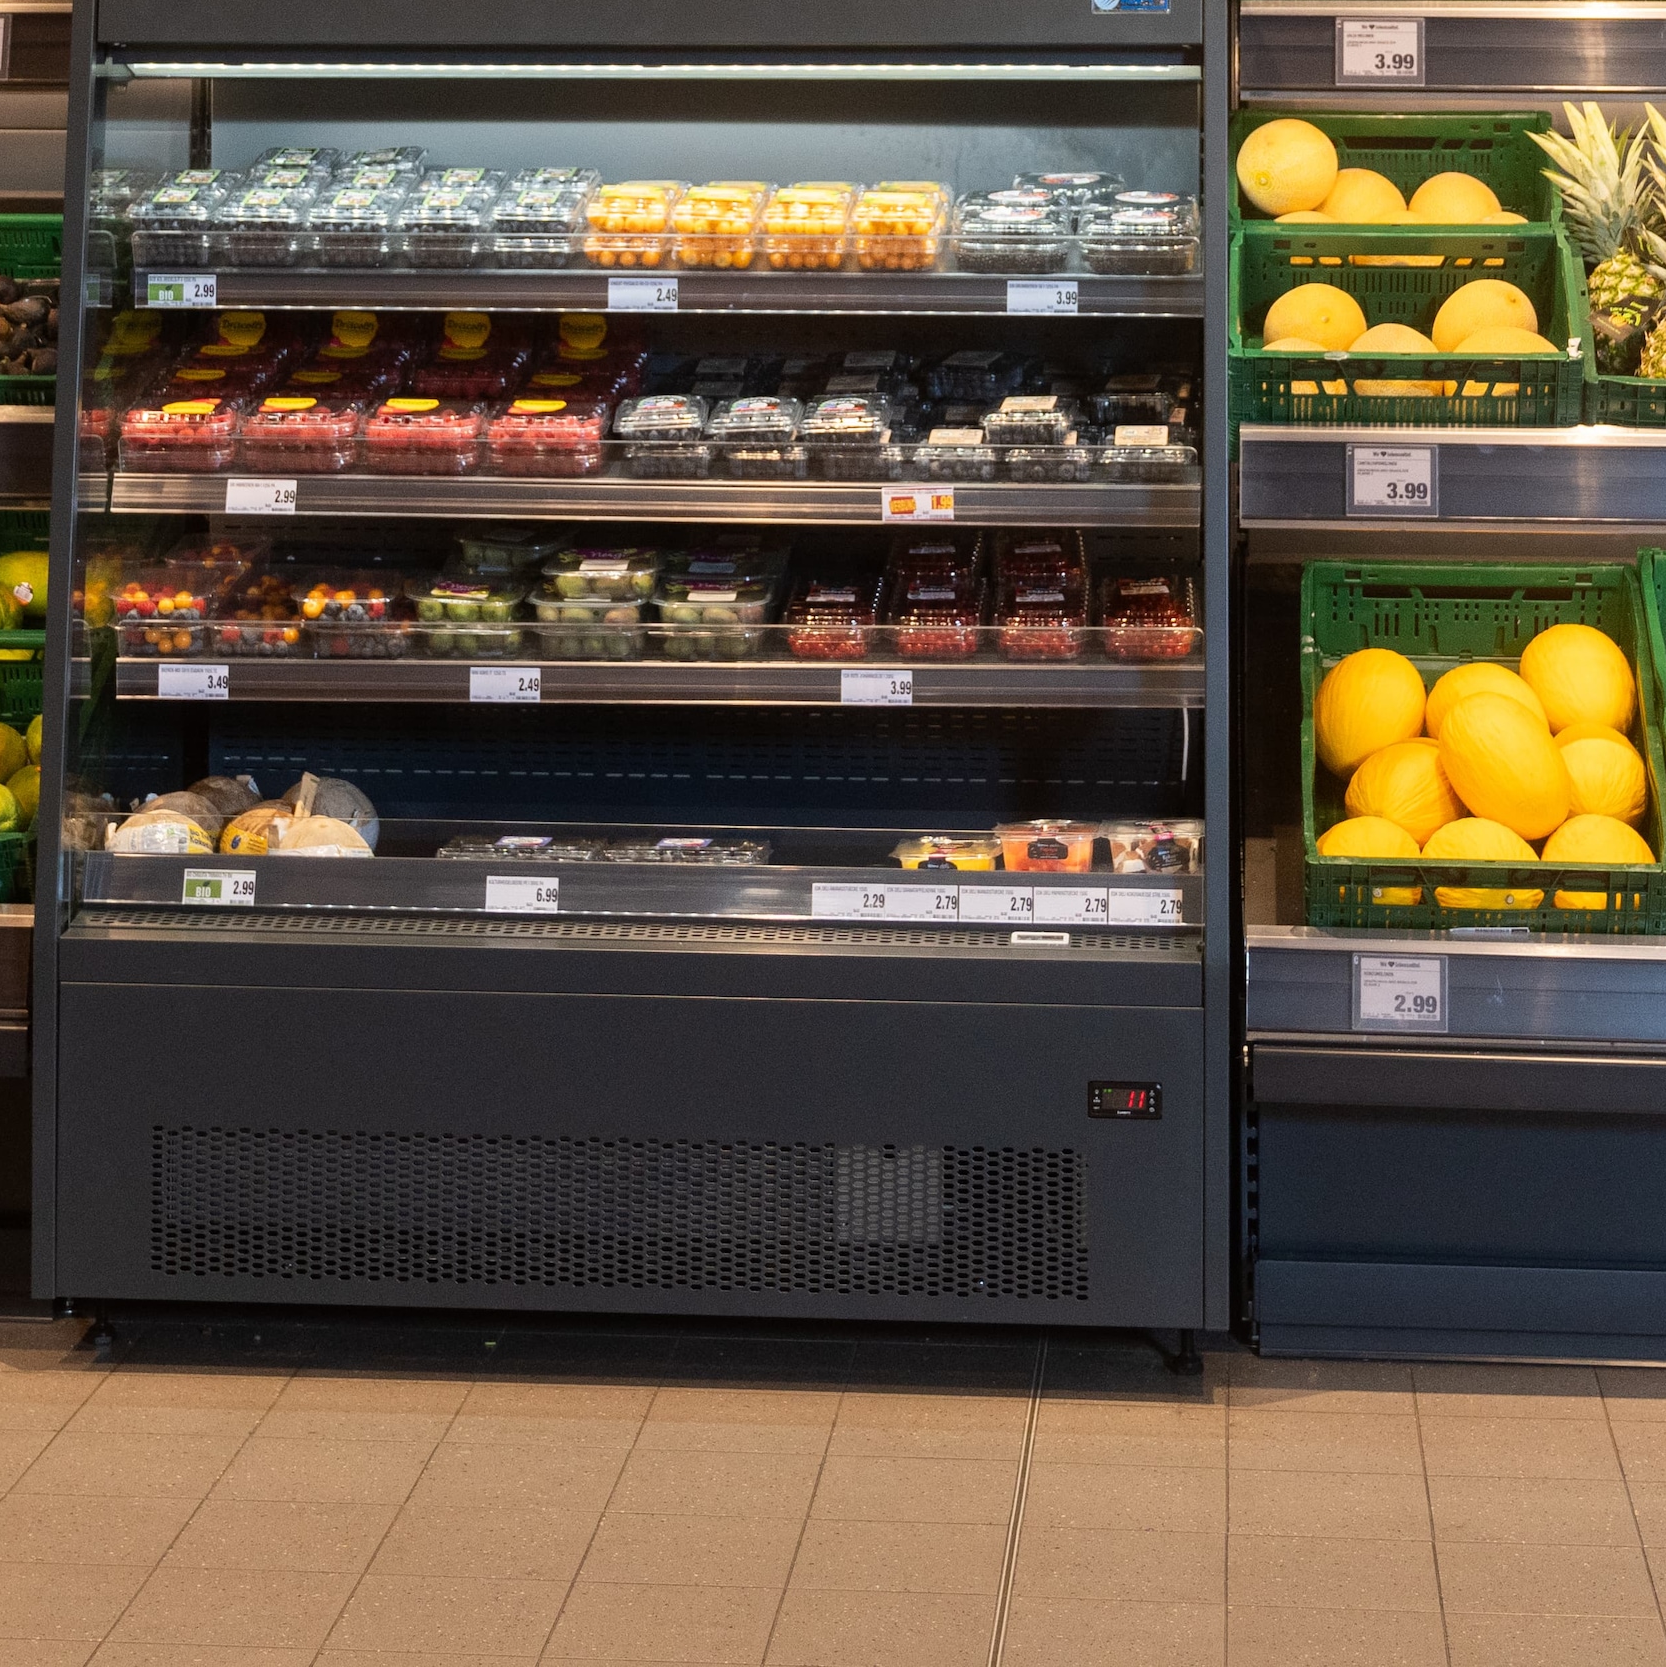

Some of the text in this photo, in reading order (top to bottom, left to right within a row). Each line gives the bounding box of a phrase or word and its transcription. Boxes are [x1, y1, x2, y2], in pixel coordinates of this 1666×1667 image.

[1374, 54, 1414, 69] 3.99
[159, 289, 174, 301] BIO
[195, 284, 215, 298] 2.99
[657, 288, 677, 302] 2.49
[1056, 291, 1077, 305] 3.99
[275, 489, 296, 504] 2.99
[1386, 482, 1428, 500] 3.99
[932, 494, 953, 510] 1.99
[207, 675, 228, 690] 3.49
[519, 677, 540, 692] 2.49
[890, 680, 912, 695] 3.99
[196, 887, 211, 898] BIO
[233, 880, 254, 895] 2.99
[536, 888, 558, 903] 6.99
[863, 893, 885, 908] 2.29
[935, 895, 957, 910] 2.79
[1011, 897, 1033, 911] 2.79
[1085, 898, 1107, 913] 2.79
[1160, 899, 1183, 914] 2.79
[1394, 995, 1437, 1014] 2.99
